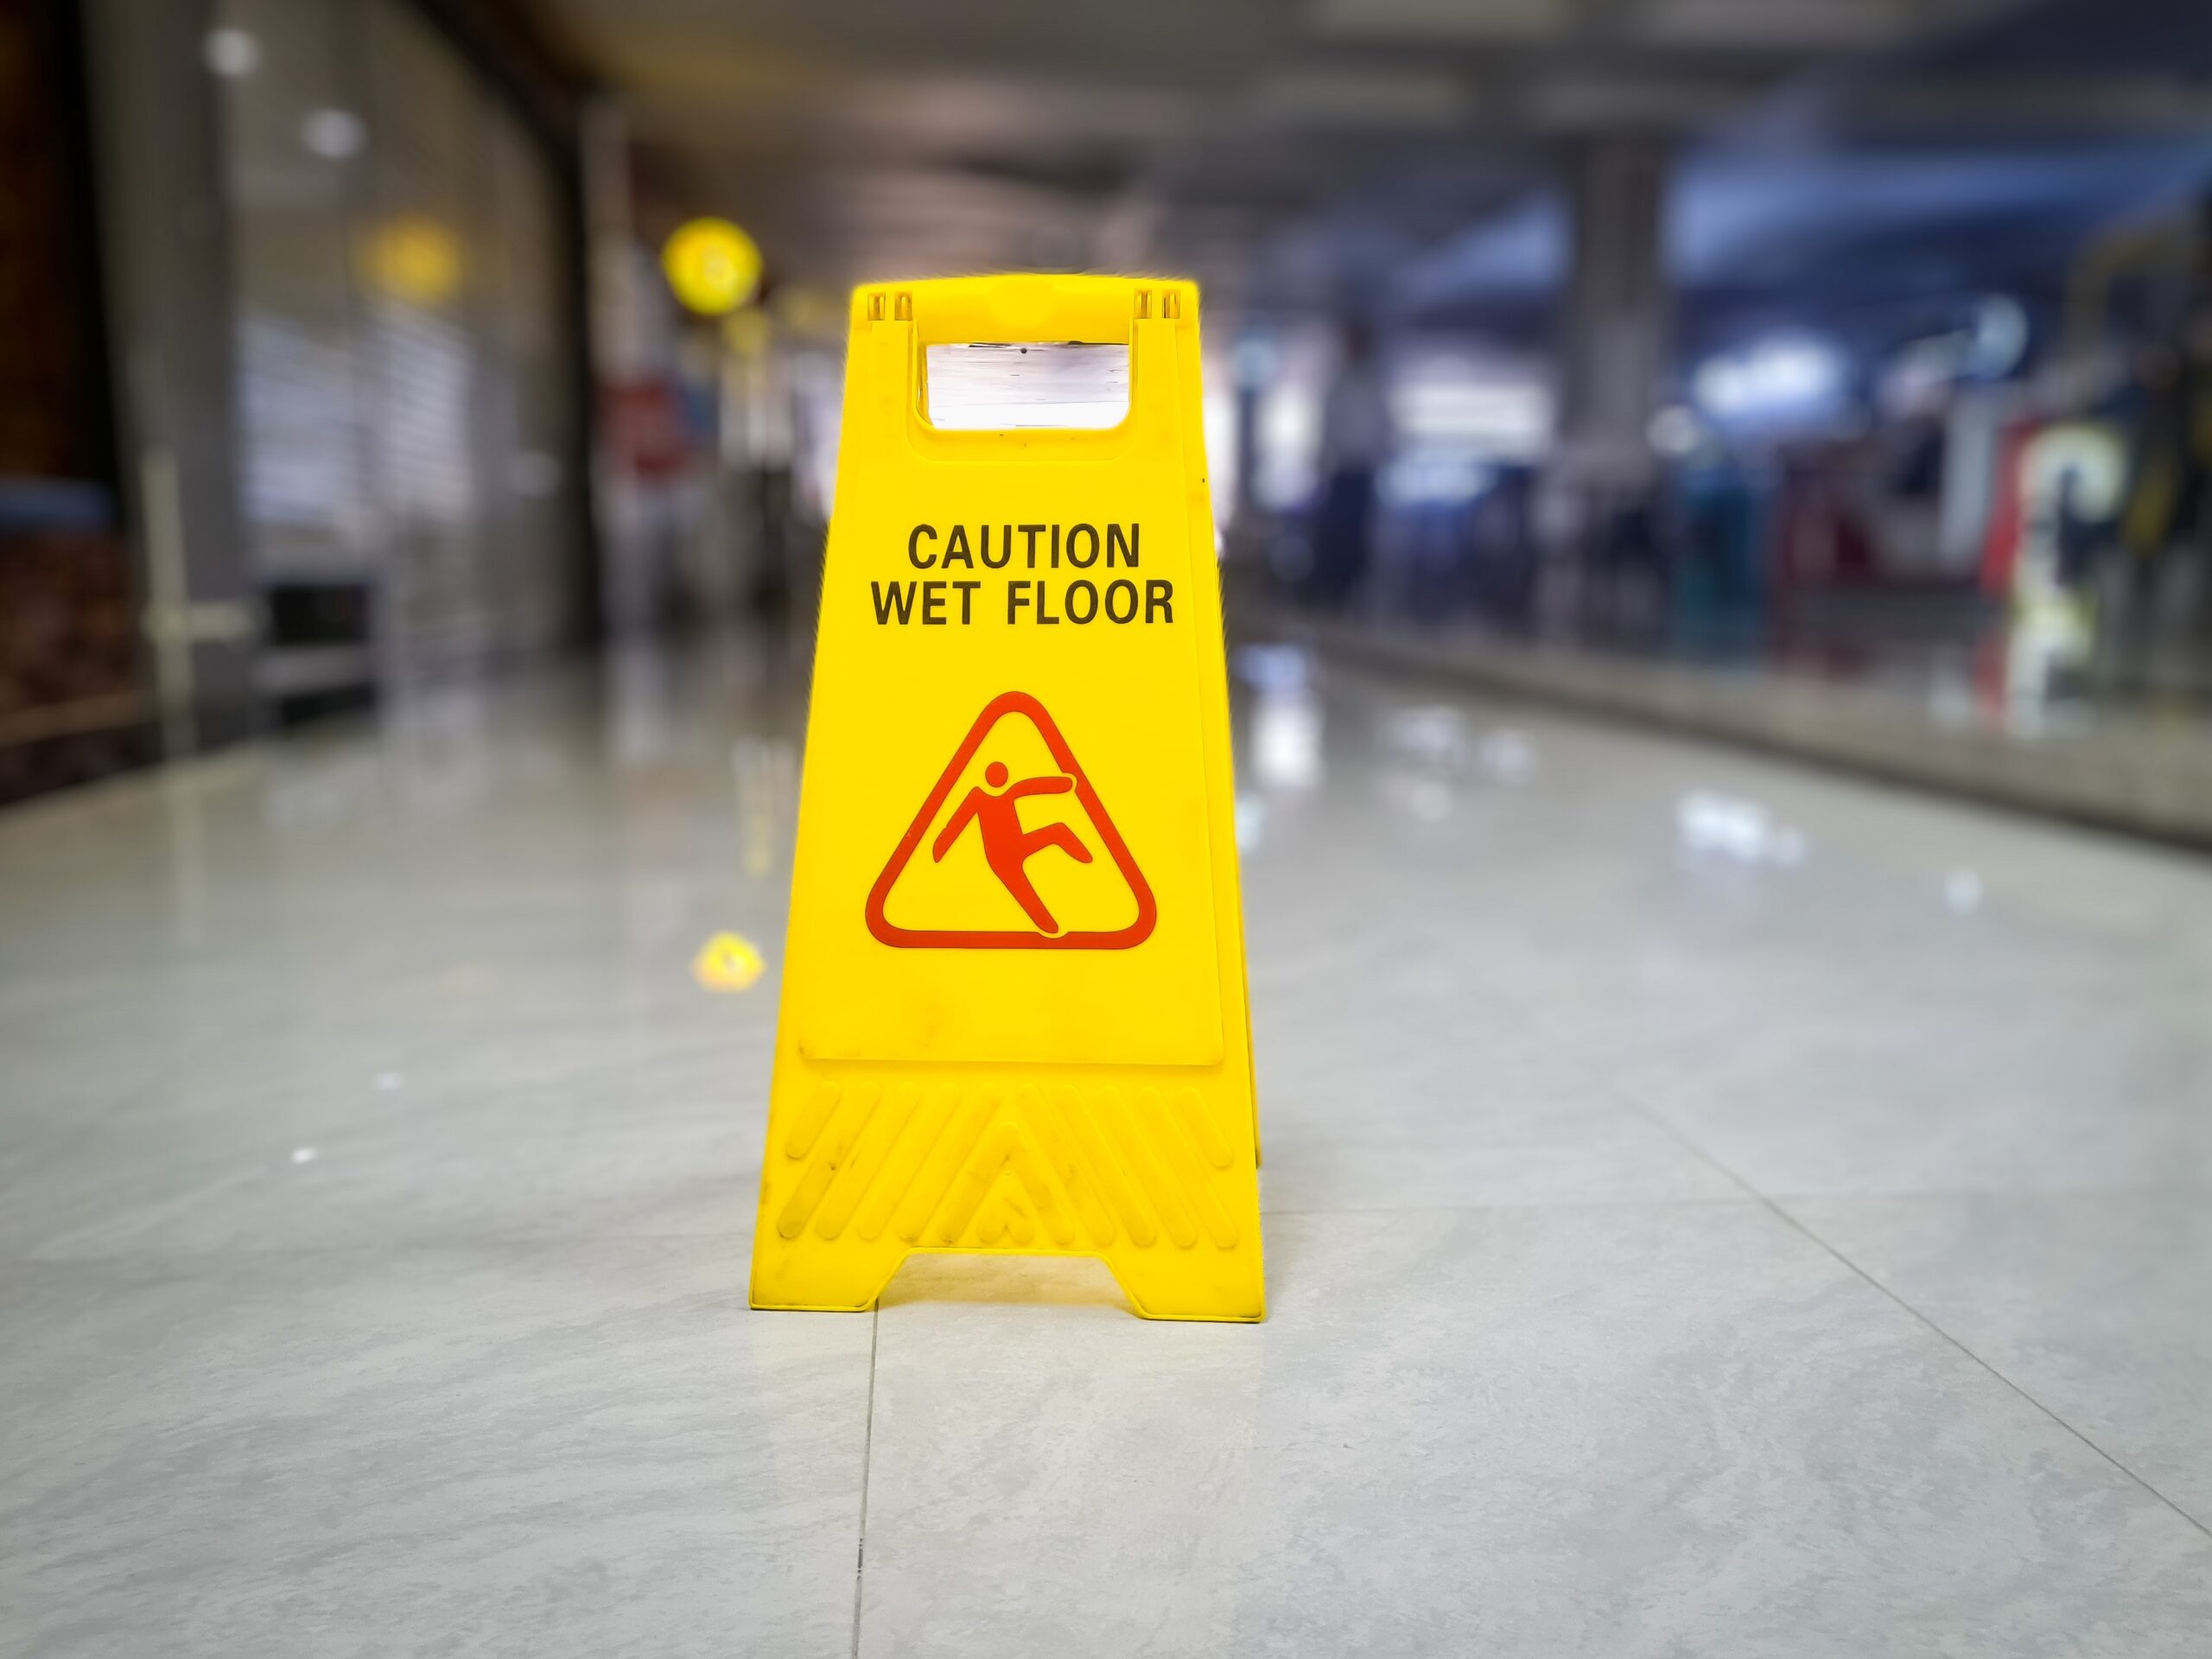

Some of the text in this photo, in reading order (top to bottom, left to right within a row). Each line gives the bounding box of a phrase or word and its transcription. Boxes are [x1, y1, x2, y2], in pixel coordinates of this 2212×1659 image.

[908, 523, 1140, 569] CAUTION
[871, 579, 1173, 625] WET FLOOR
